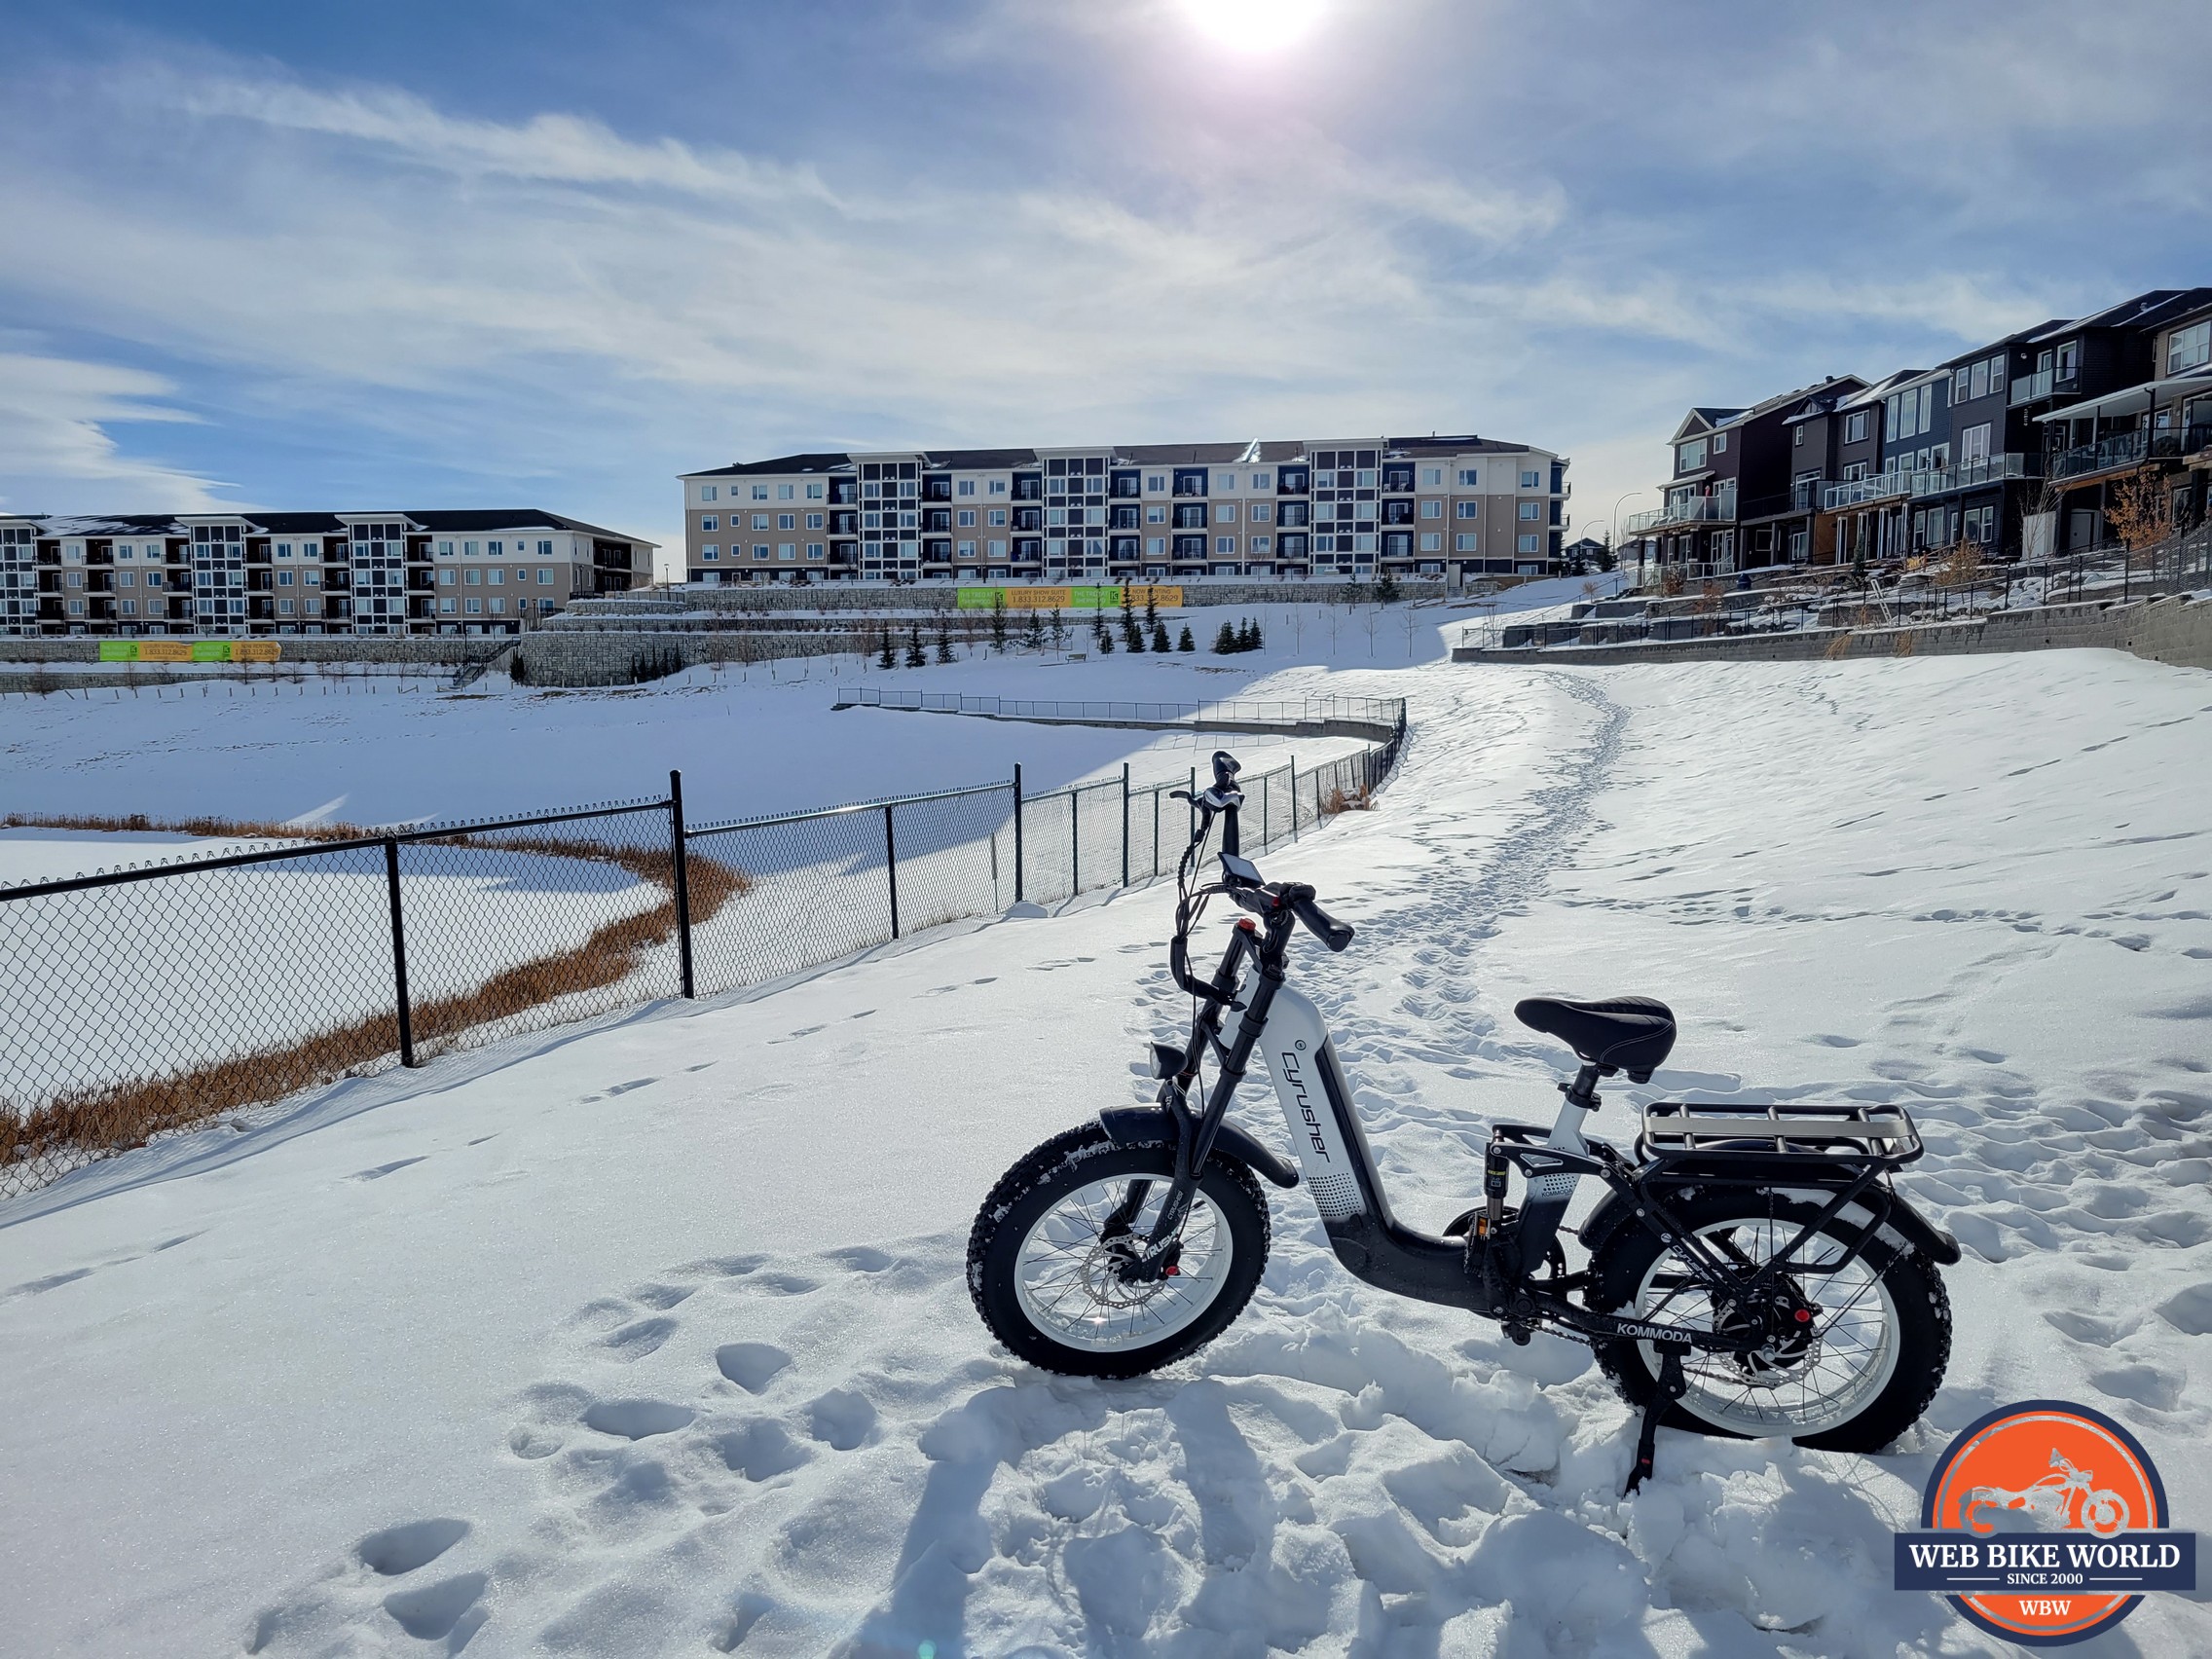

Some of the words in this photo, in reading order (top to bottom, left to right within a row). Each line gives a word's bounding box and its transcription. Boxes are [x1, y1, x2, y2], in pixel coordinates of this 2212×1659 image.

[1281, 1052, 1331, 1163] Cyrusher
[1542, 1188, 1572, 1198] KOMMODA
[1617, 1323, 1692, 1344] KOMMODA
